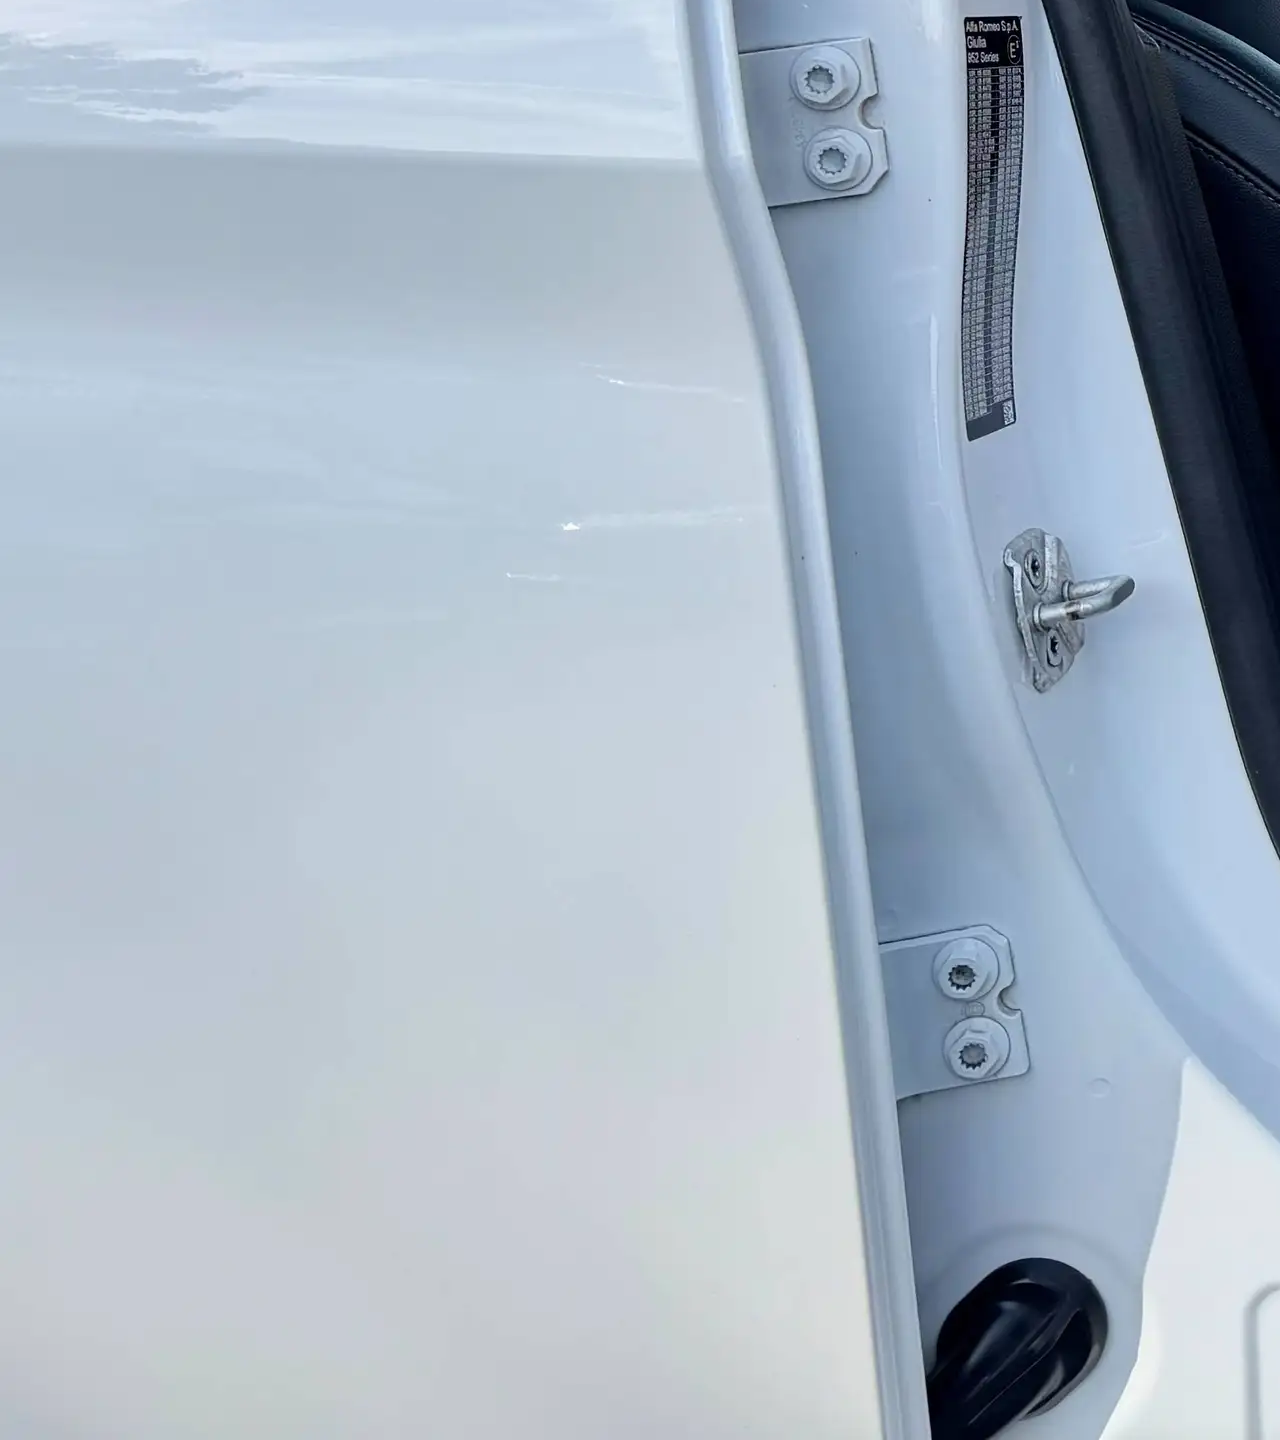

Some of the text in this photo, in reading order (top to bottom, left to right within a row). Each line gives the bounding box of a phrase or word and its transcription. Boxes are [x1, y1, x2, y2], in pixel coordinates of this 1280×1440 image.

[966, 21, 978, 32] Alfa
[979, 21, 1000, 32] Romeo
[967, 35, 987, 48] Giulia
[980, 52, 999, 62] Series
